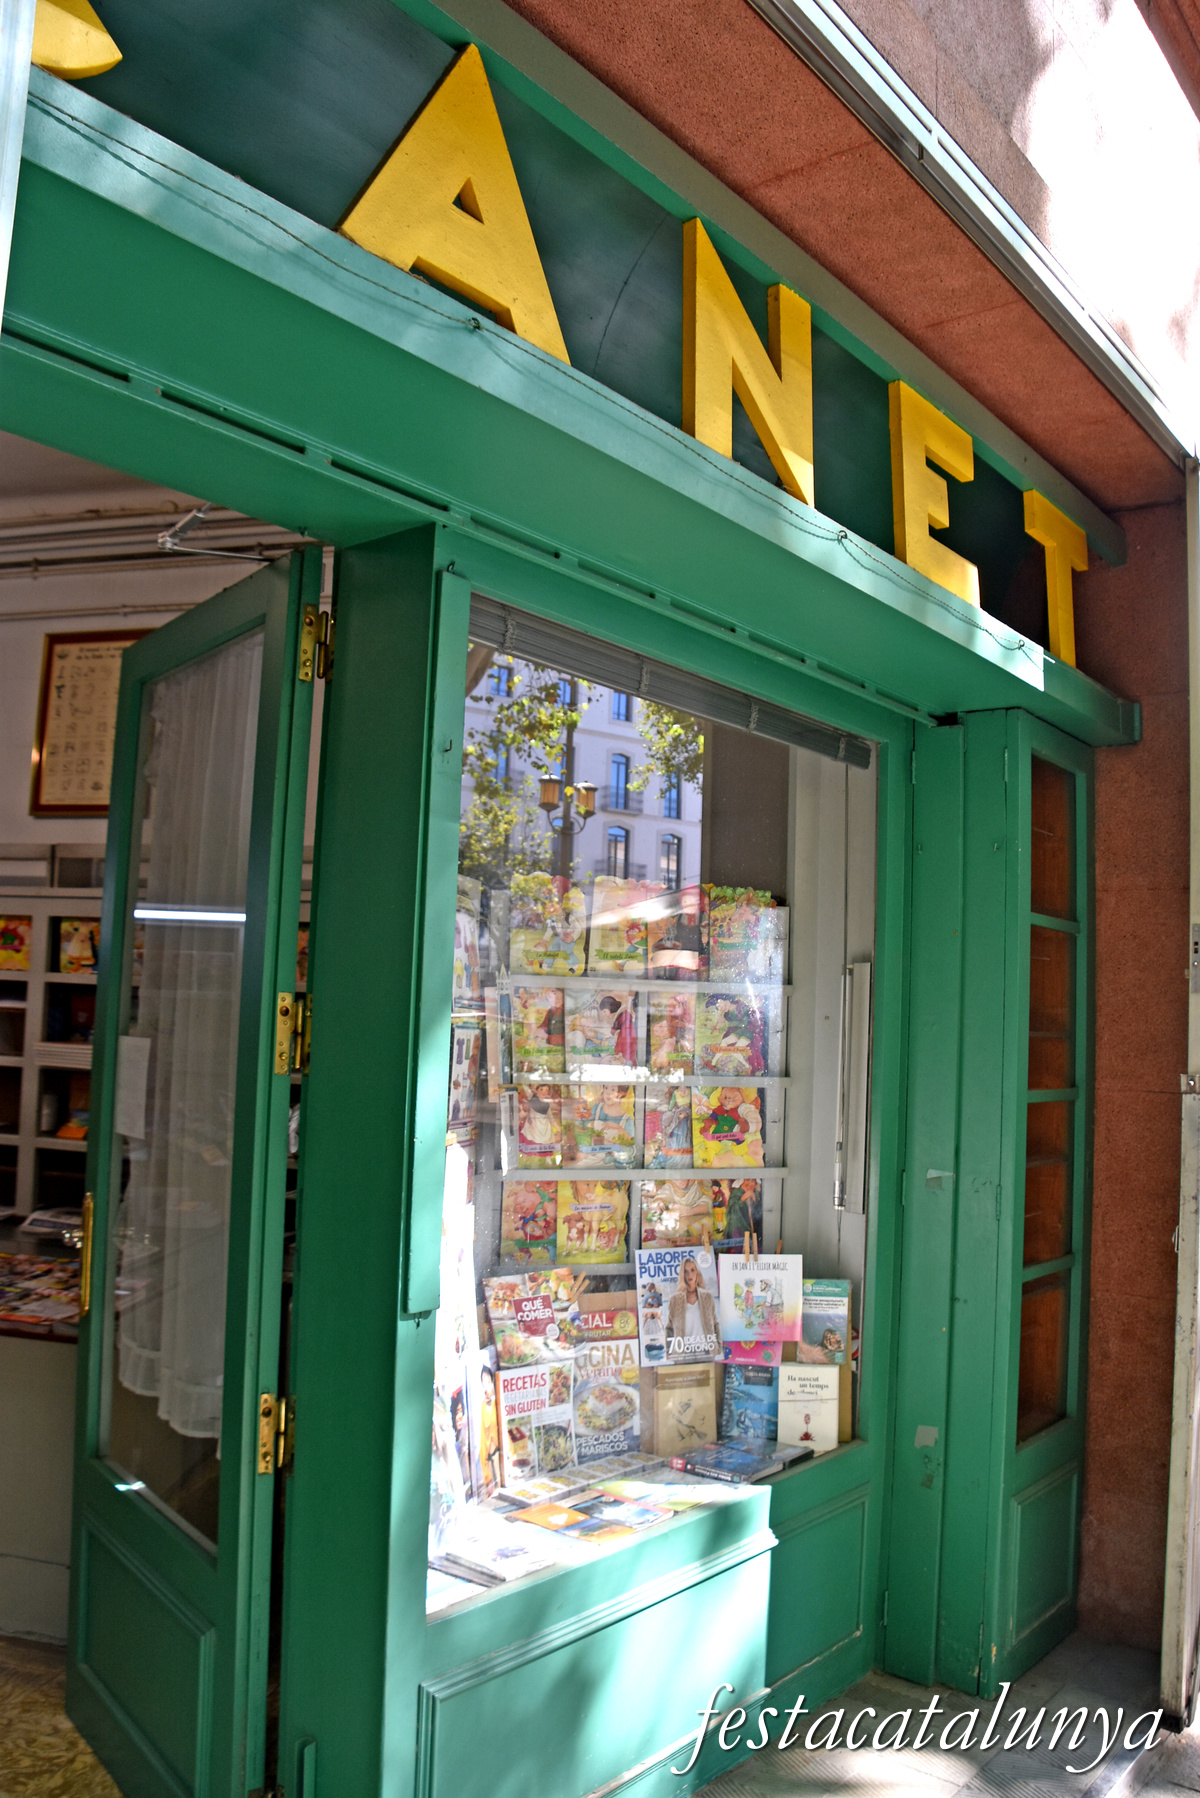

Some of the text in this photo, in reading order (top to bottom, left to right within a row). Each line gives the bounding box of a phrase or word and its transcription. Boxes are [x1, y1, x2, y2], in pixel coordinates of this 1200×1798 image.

[31, 0, 1089, 668] ANET
[638, 1250, 695, 1265] LABORES
[522, 1297, 544, 1311] QUÉ
[517, 1308, 553, 1321] COMER
[666, 1333, 717, 1354] 70 IDEAS DE
[502, 1372, 547, 1393] RECETAS
[809, 1382, 829, 1391] temps
[504, 1404, 516, 1416] SIN
[517, 1398, 547, 1413] GLUTEN
[576, 1431, 625, 1447] PESCADOS
[581, 1441, 628, 1456] MARISCOS
